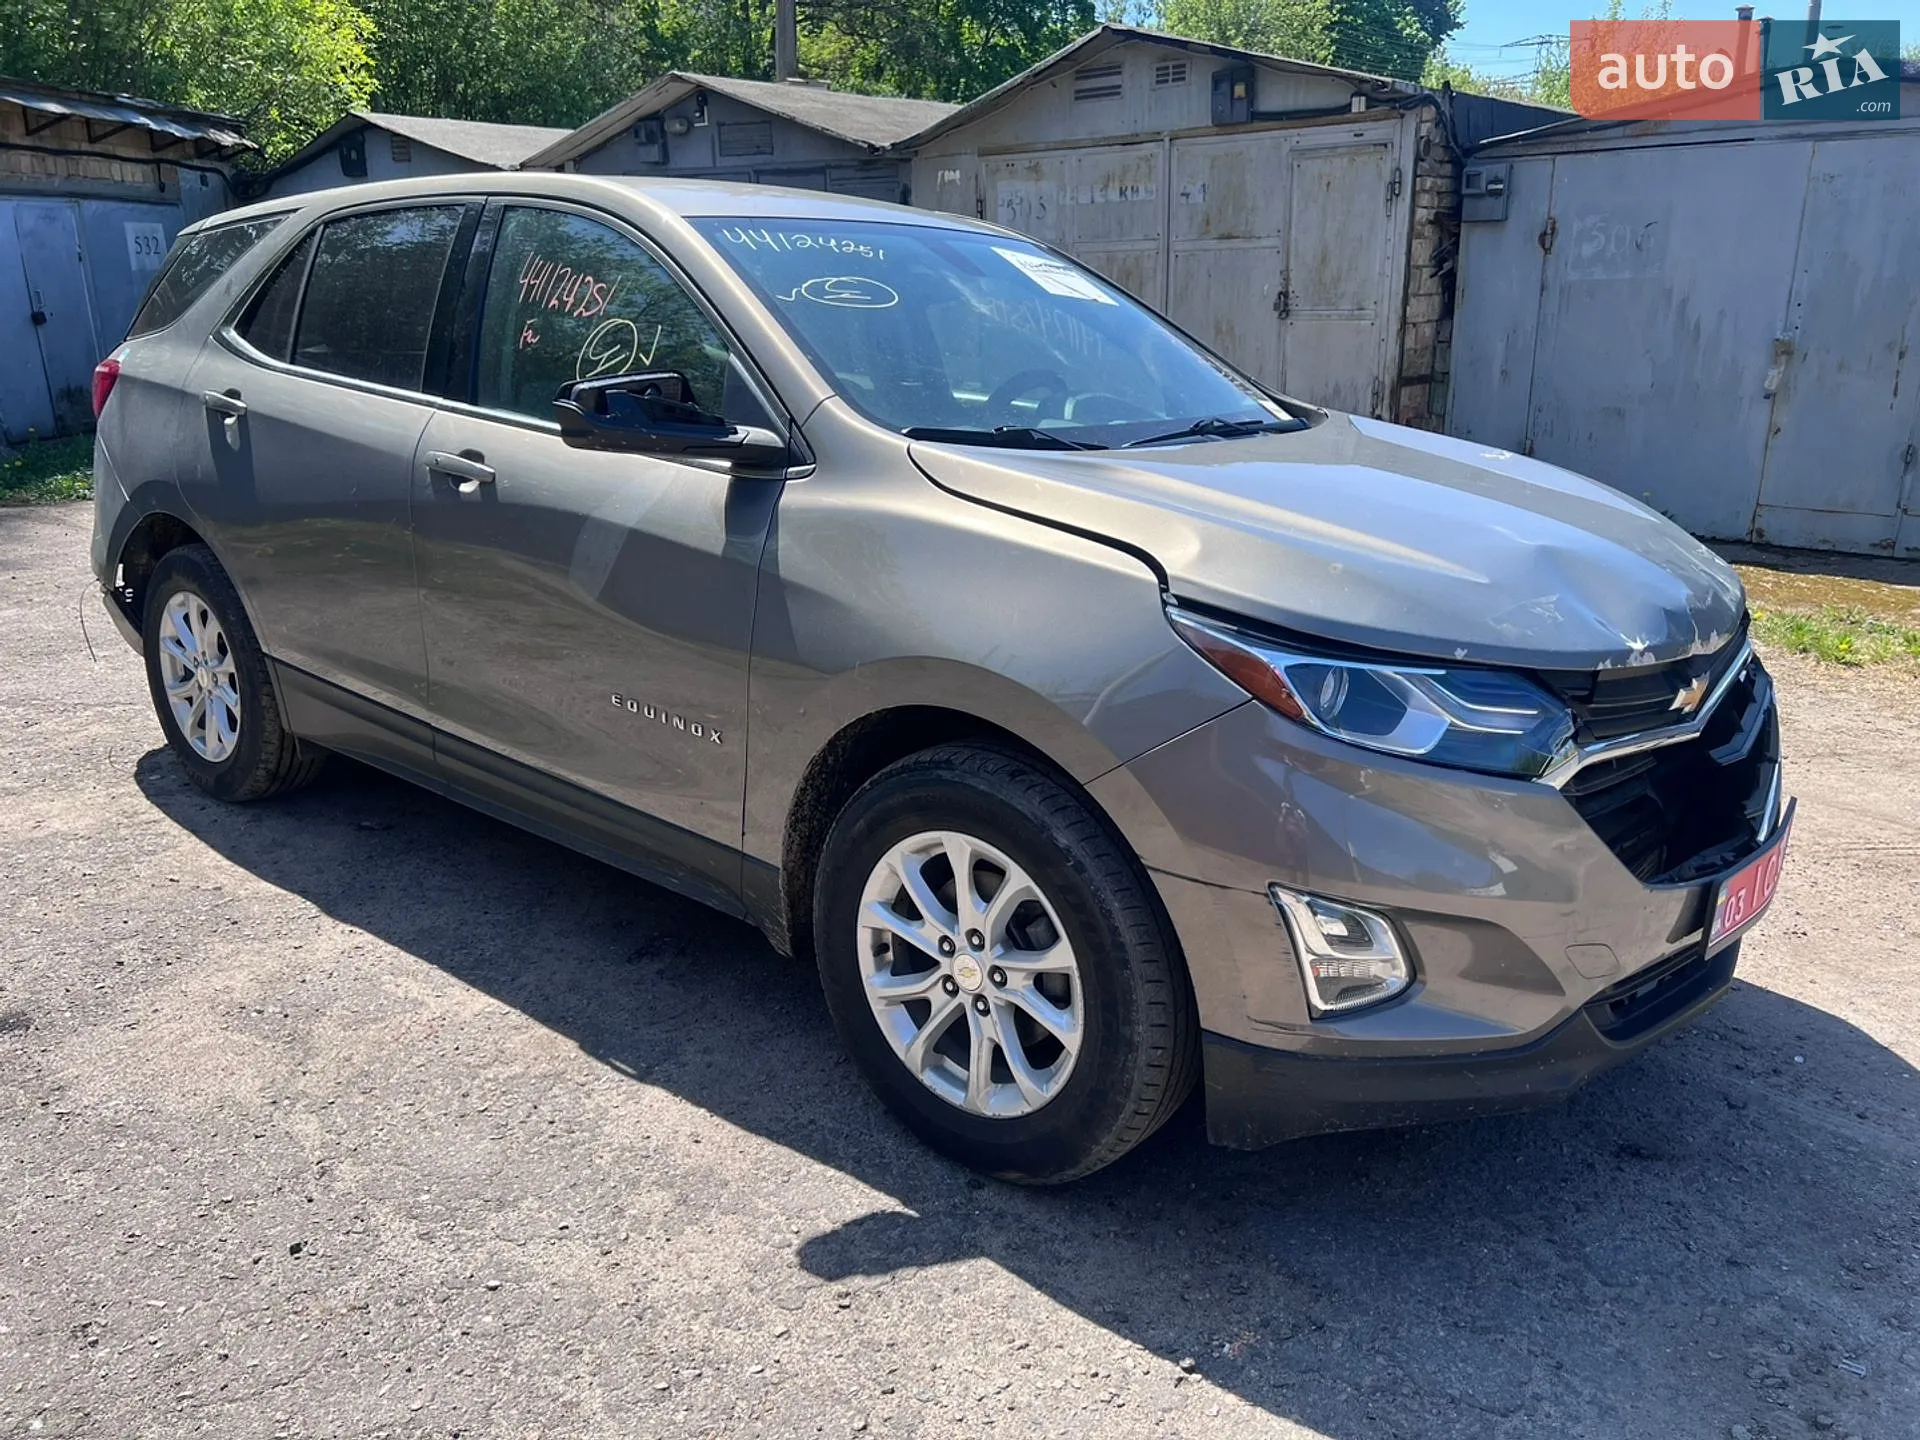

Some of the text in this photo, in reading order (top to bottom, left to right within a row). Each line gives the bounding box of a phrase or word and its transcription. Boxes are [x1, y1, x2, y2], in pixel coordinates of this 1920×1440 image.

[134, 235, 160, 255] 532
[611, 694, 722, 745] EQUINOX
[1724, 888, 1747, 928] 03
